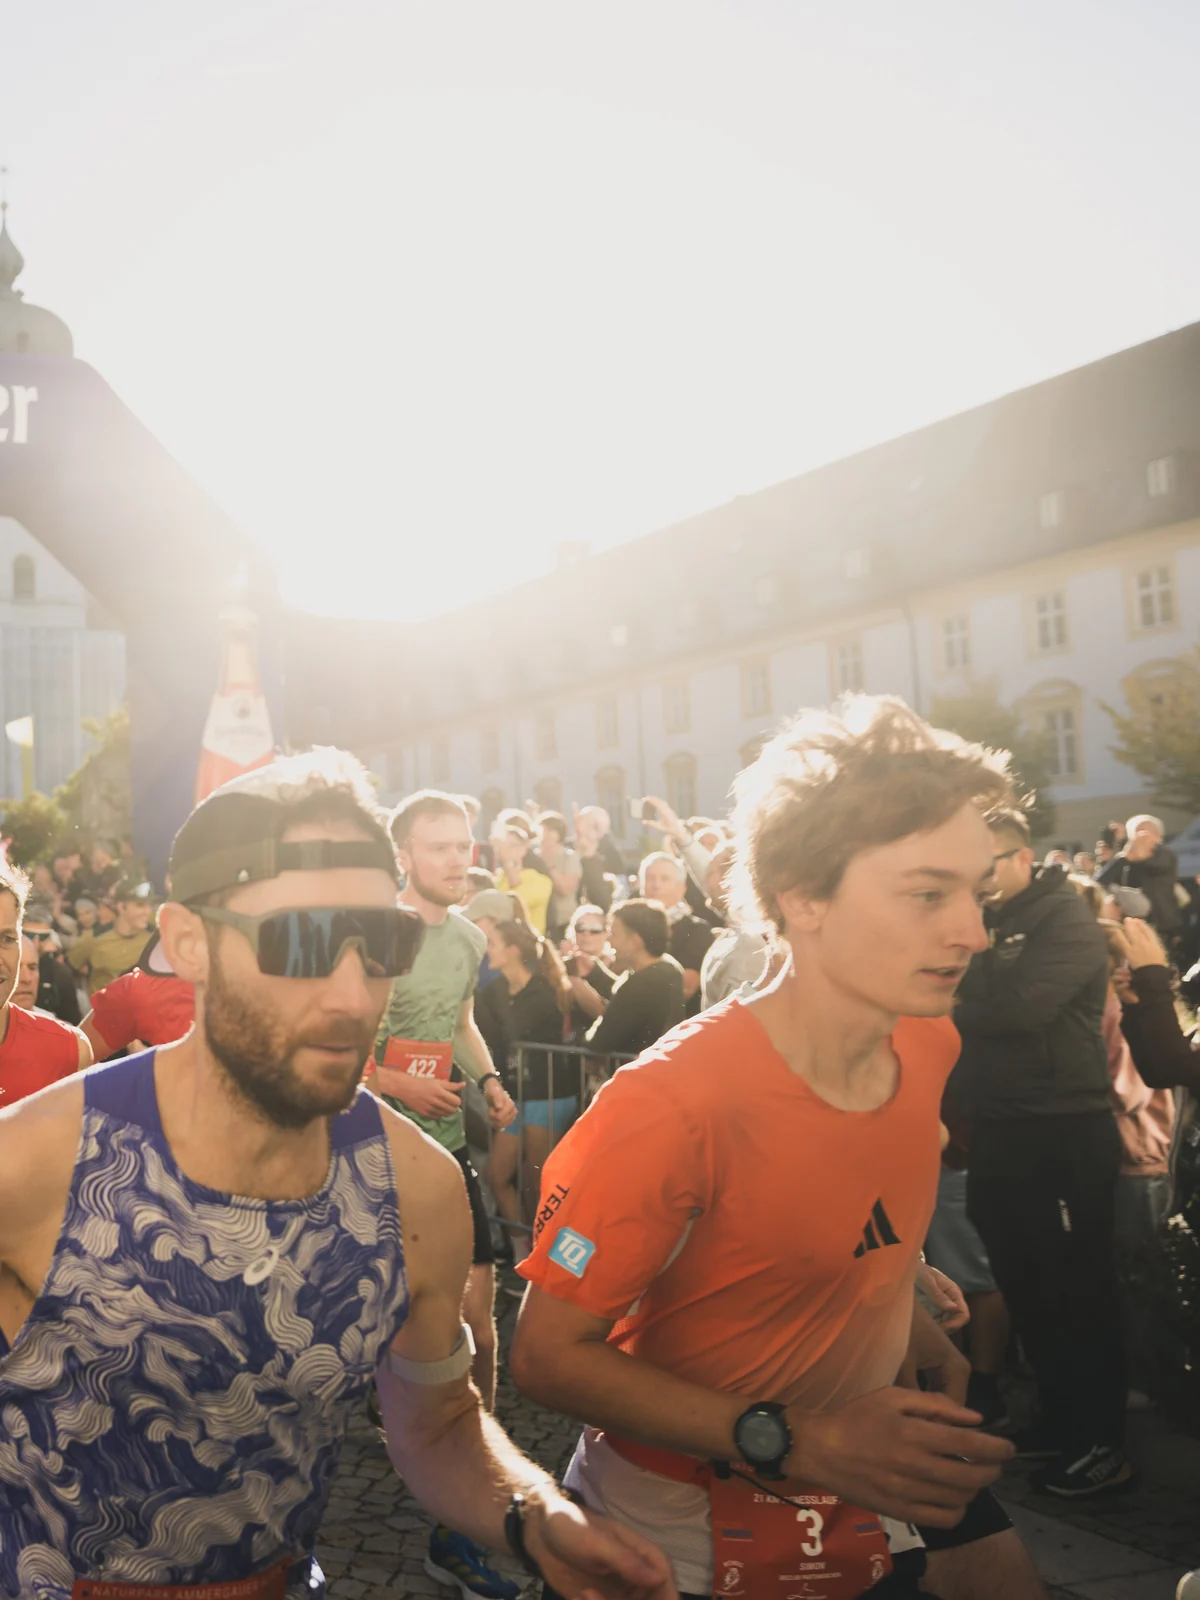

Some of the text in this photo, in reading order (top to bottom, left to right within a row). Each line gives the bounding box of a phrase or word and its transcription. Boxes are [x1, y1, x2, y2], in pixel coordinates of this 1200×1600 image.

[407, 1059, 438, 1079] 422
[535, 1184, 571, 1234] TERR
[558, 1232, 587, 1270] TQ
[753, 1493, 764, 1502] 21
[796, 1508, 824, 1557] 3
[91, 1580, 259, 1600] NATURPARK AMMERGAUER
